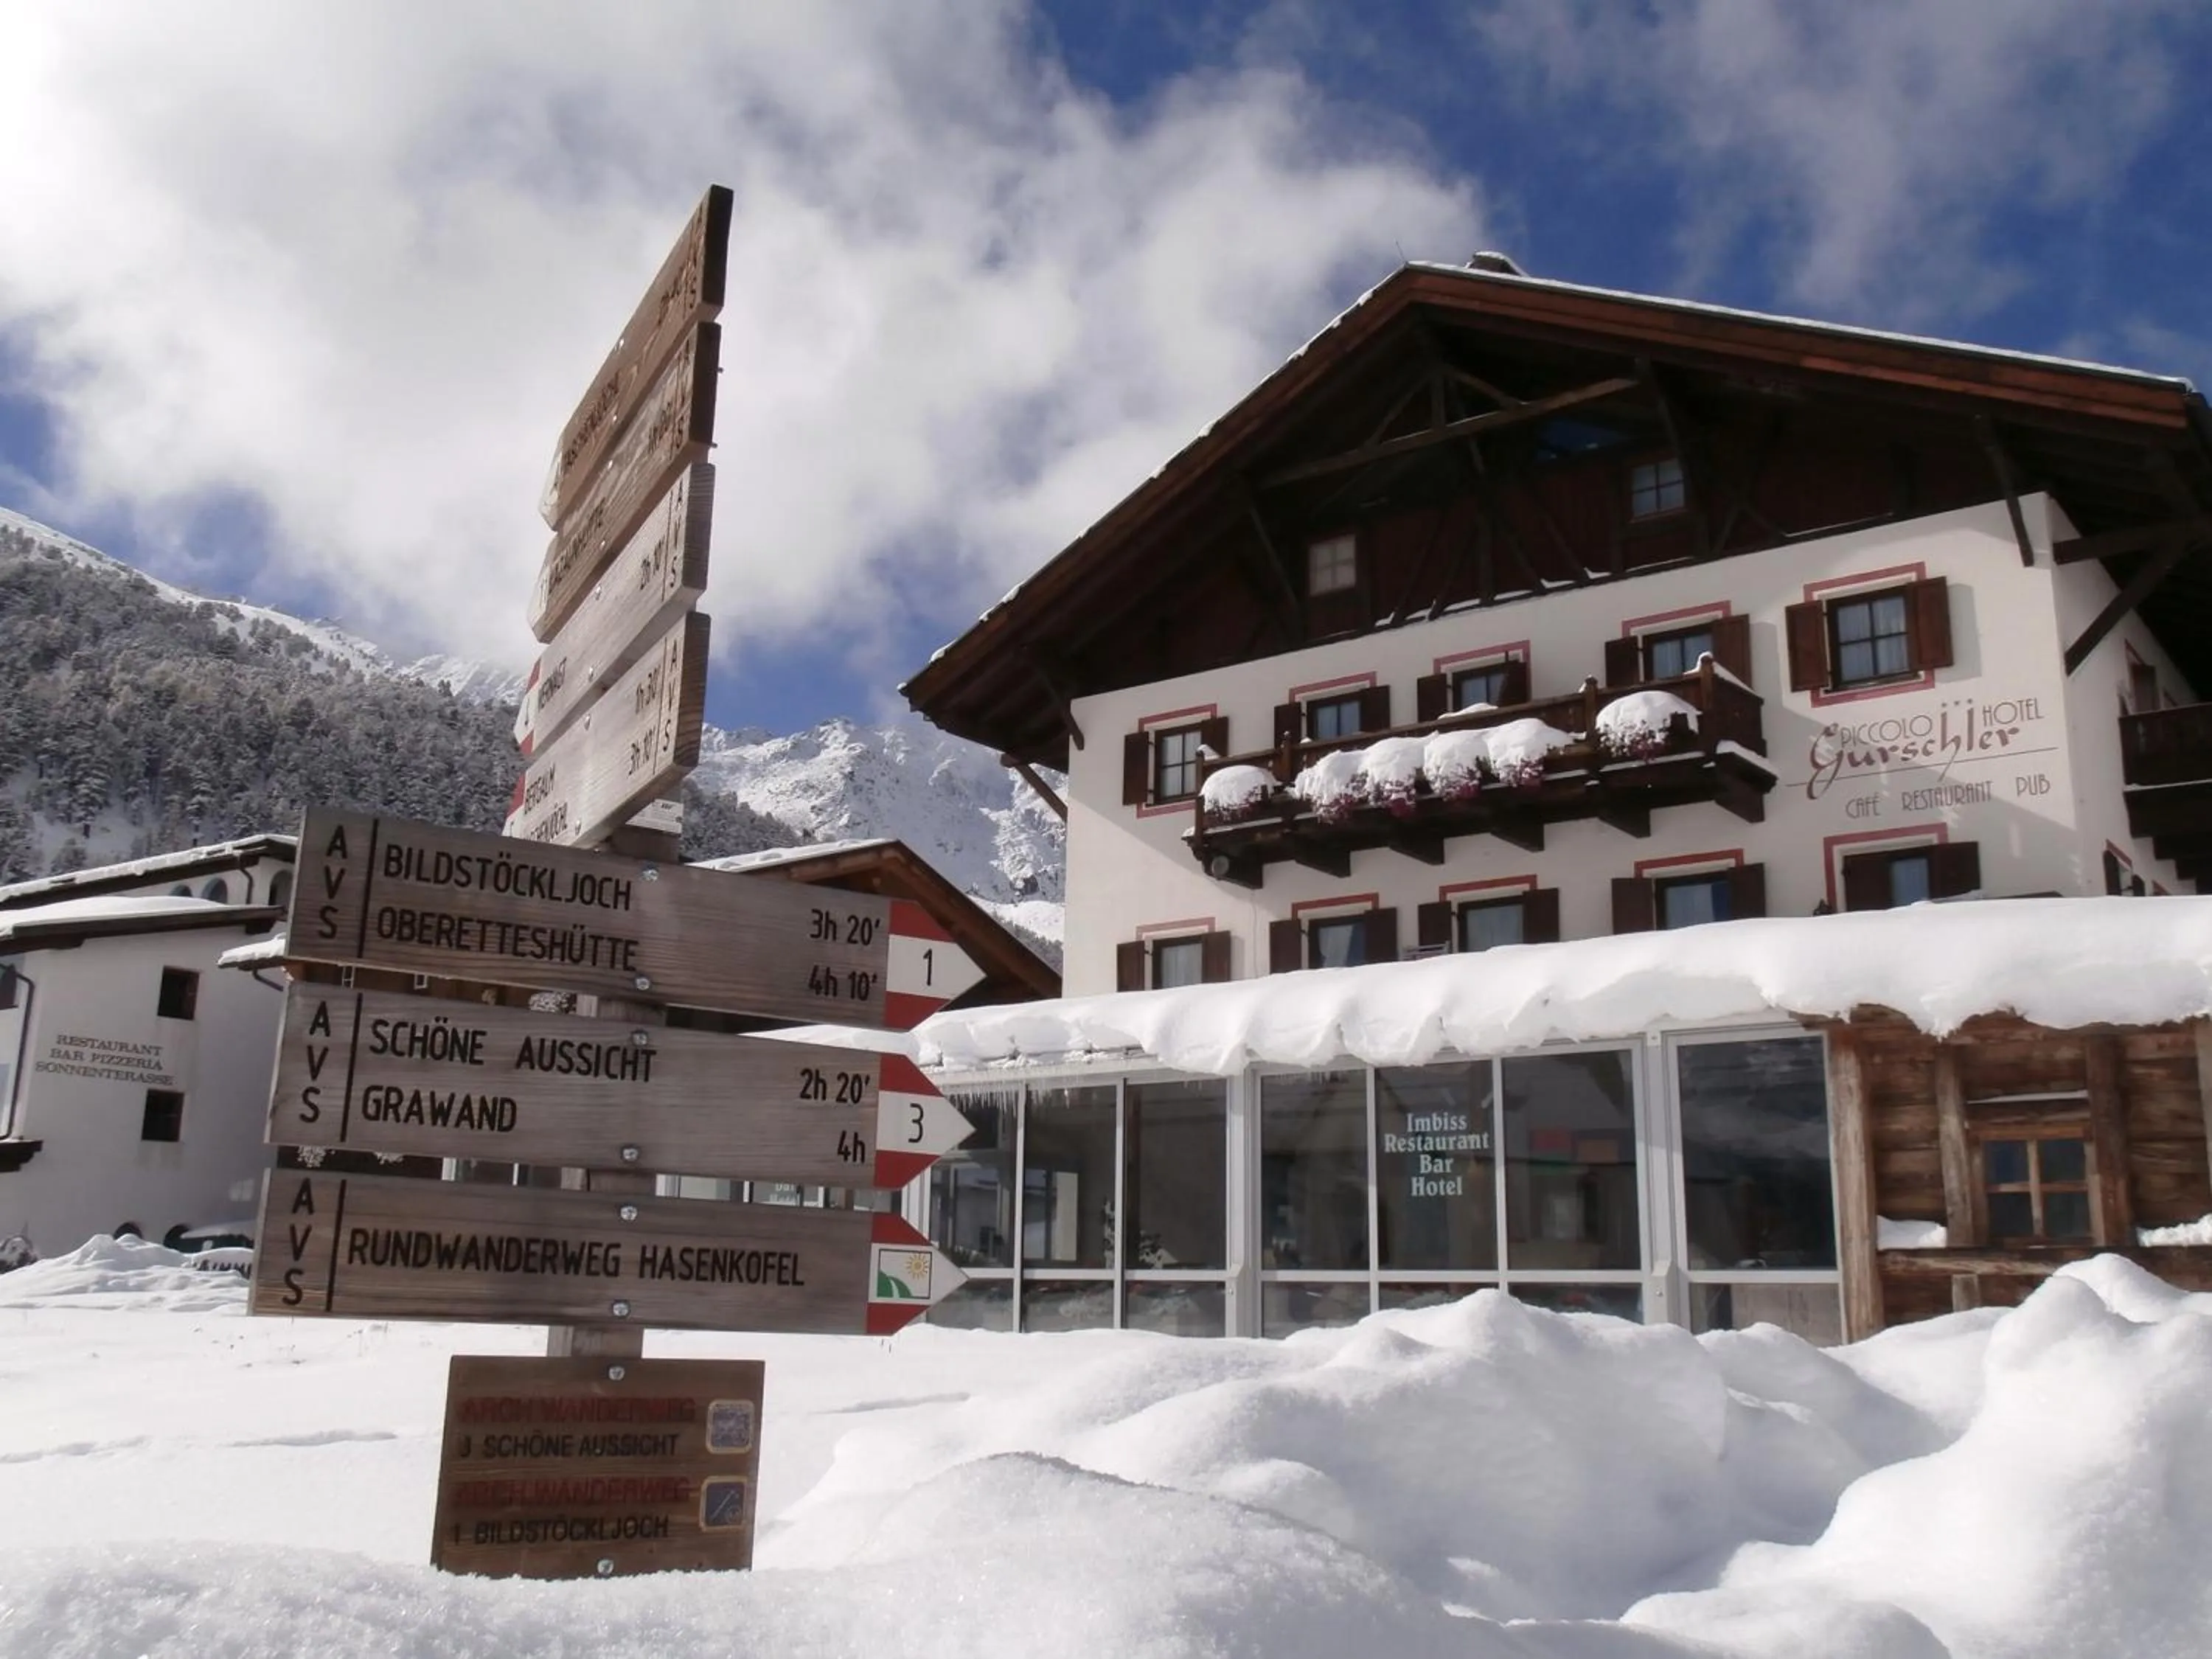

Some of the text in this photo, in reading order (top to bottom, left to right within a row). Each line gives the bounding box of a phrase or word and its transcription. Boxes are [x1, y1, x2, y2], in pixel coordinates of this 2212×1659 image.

[1840, 698, 2045, 748] PICCOLO HOTEL
[1846, 773, 2051, 818] CAFÉ RESTAURANT PUB
[383, 844, 881, 947] BILDSTÖCKLJOCH 3h 20'
[377, 906, 878, 1001] OBERETTESHÜTTE 4h 10'
[922, 948, 933, 987] 1
[49, 1048, 164, 1071] BAR PIZZERIA
[56, 1034, 164, 1057] RESTAURANT
[369, 1015, 871, 1105] SCHÖNE AUSSICHT 2h 20'
[36, 1062, 173, 1086] SONNENTERASSE
[361, 1084, 866, 1164] GRAWAND 4h
[908, 1103, 925, 1144] 3
[1406, 1112, 1467, 1133] Imbiss
[1384, 1132, 1490, 1153] Restaurant
[1419, 1154, 1454, 1174] Bar
[1411, 1177, 1463, 1197] Hotel
[347, 1227, 805, 1287] RUNDWANDERWEG HASENKOFEL
[483, 1429, 574, 1458] SCHÖNE
[578, 1433, 680, 1457] AUSSICHT
[474, 1514, 669, 1545] BILDSTÖCKLJOCH
